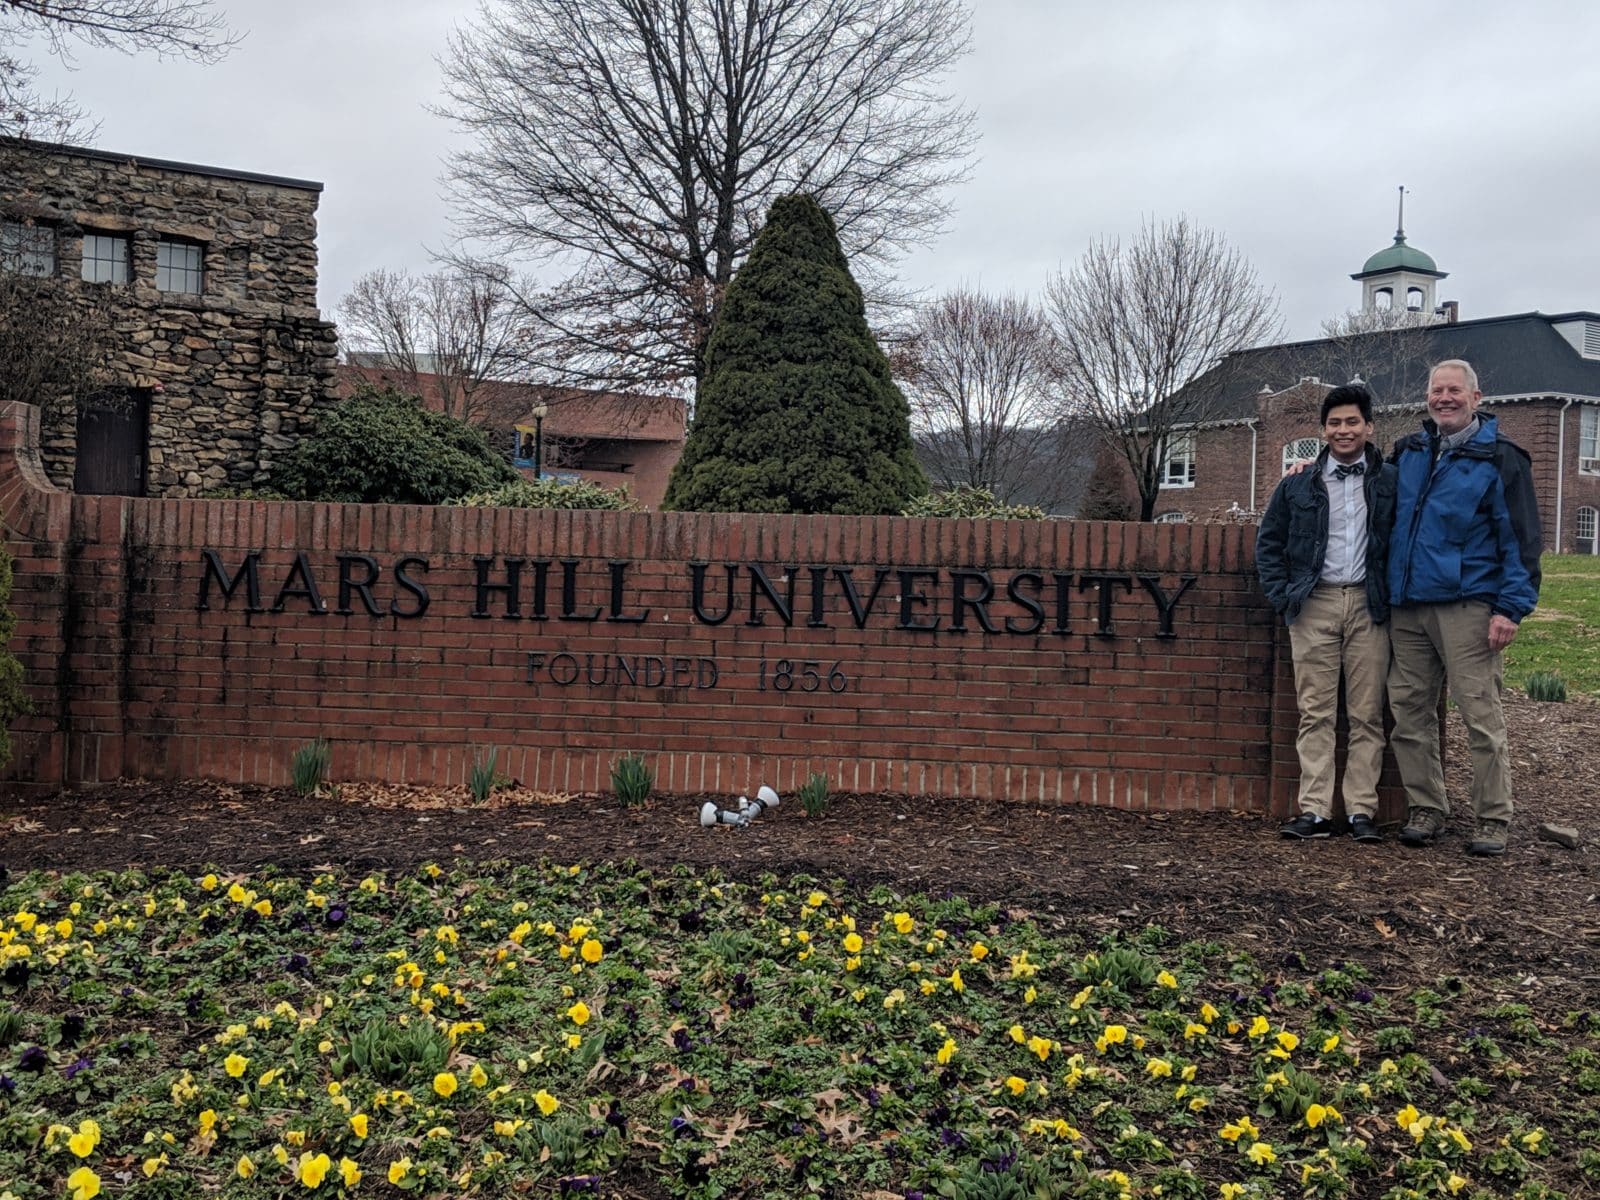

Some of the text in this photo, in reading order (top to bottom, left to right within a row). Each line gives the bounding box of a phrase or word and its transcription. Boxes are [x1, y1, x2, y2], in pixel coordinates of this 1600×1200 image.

[196, 547, 1196, 638] MARS HILL UNIVERSITY
[527, 651, 848, 694] FOUNDED 1856
